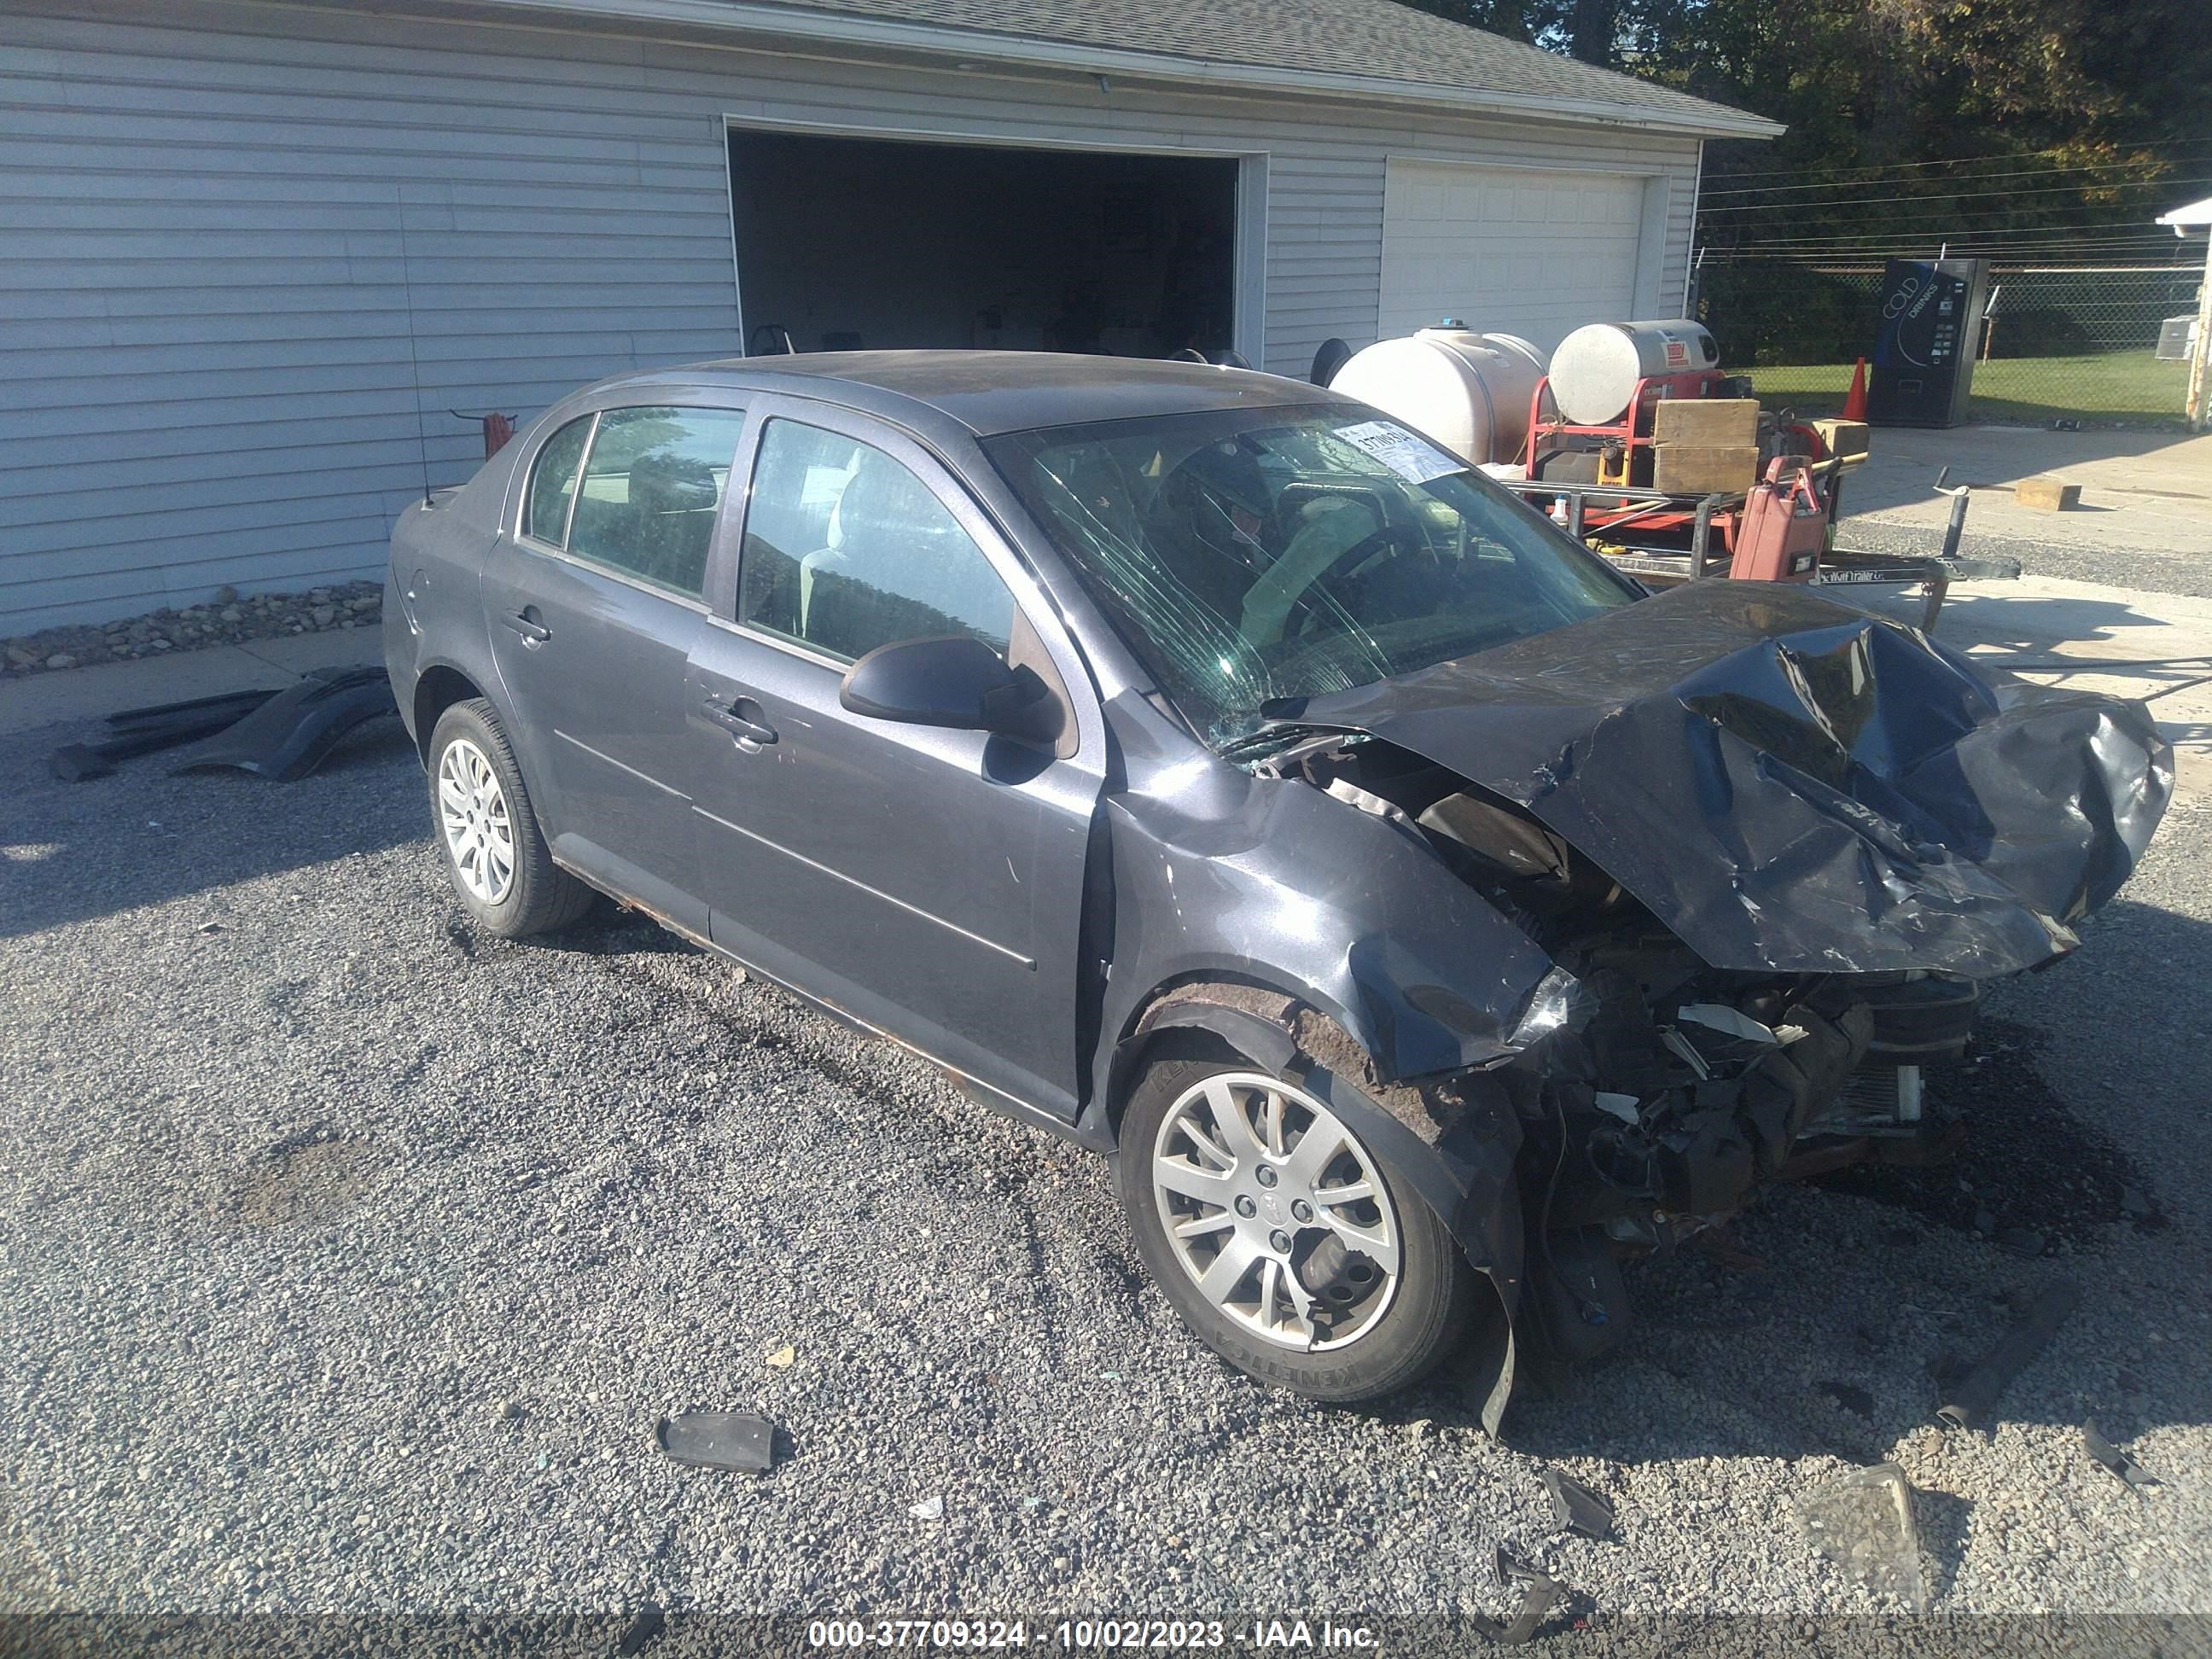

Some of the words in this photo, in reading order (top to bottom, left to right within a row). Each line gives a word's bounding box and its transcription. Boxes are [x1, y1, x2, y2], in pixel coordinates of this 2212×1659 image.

[1883, 277, 1918, 319] COLD
[1907, 283, 1939, 319] DRINKS
[1849, 570, 1874, 582] Trailer
[1215, 1330, 1360, 1388] KENETICA
